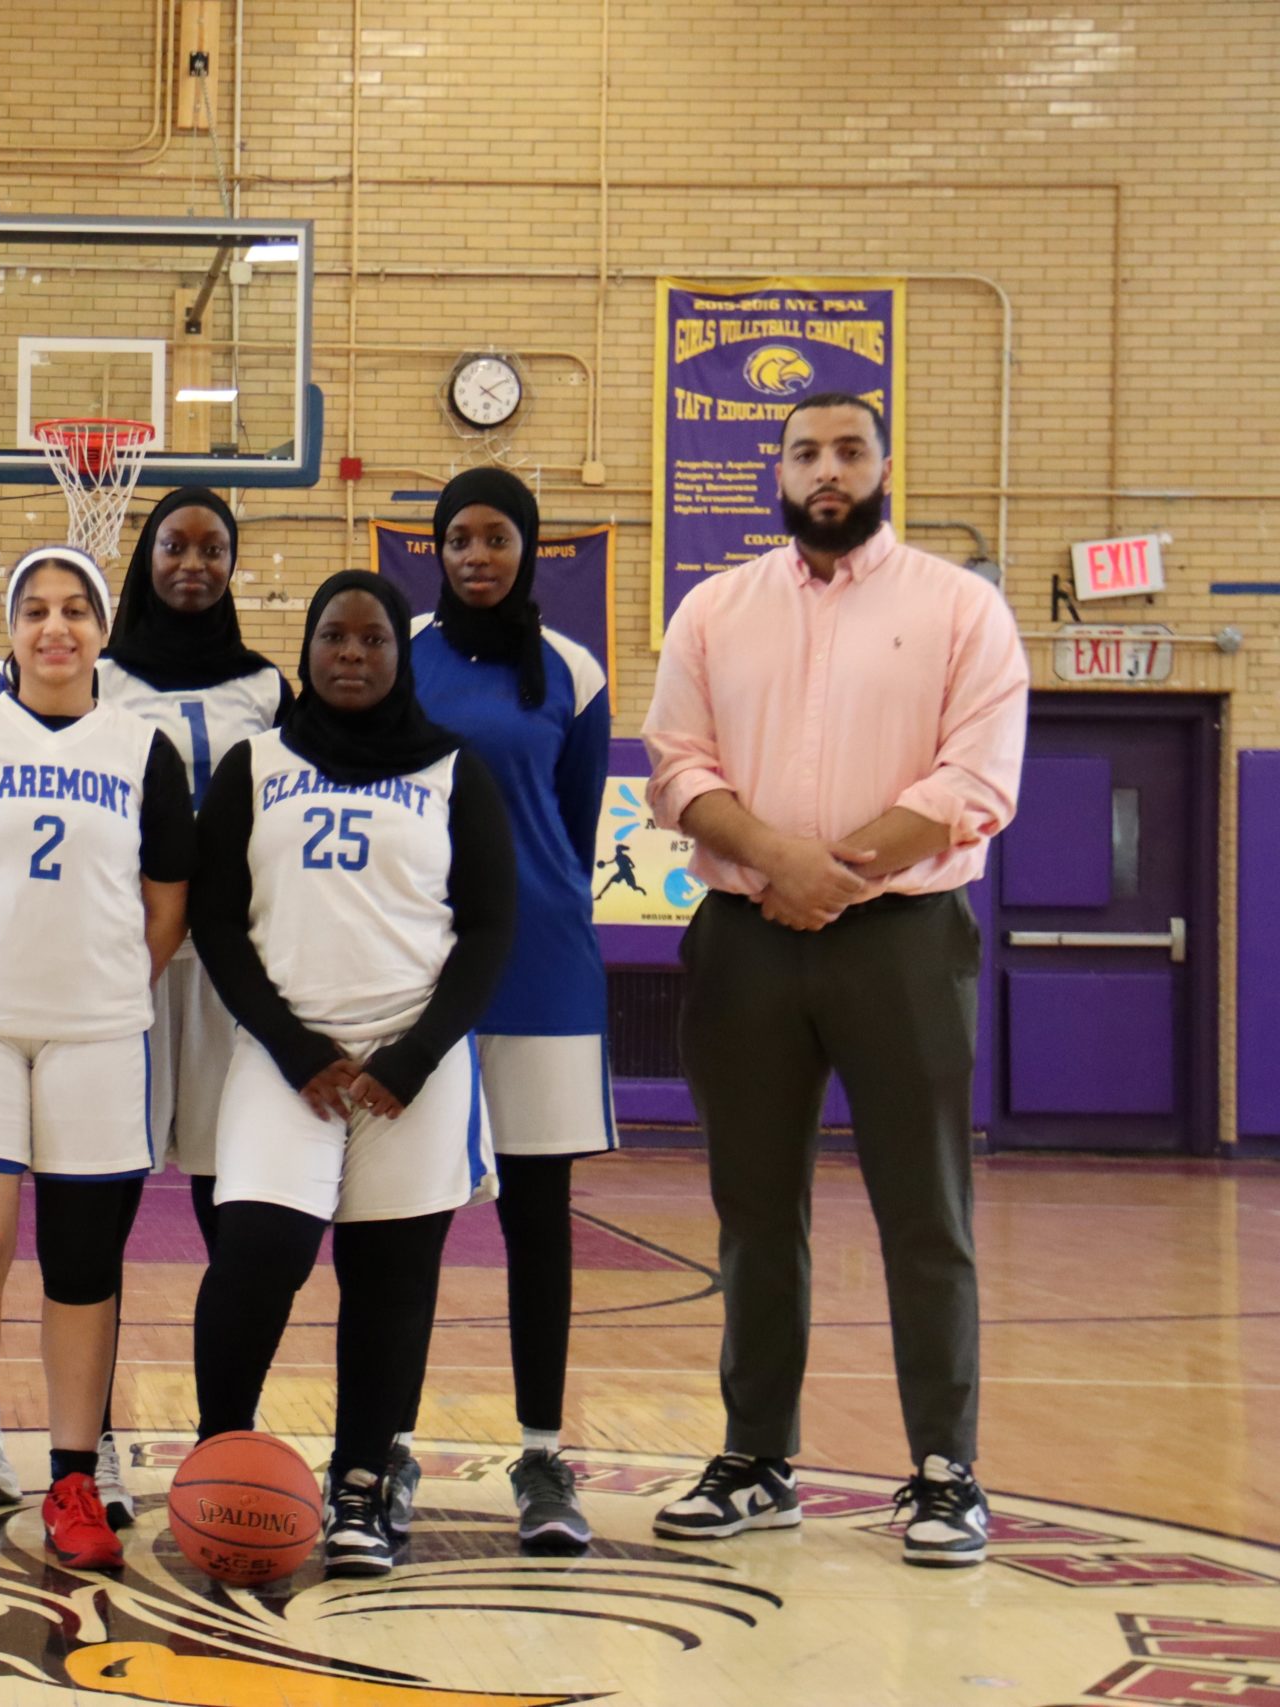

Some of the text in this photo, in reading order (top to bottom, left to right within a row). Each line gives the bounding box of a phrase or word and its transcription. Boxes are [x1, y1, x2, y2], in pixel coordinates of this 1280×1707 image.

[675, 319, 884, 366] GIRLS VOLLEYBALL CHAMPIONS
[674, 387, 797, 421] TAFT EDUCATIO
[406, 541, 577, 559] TAFT AMPUS
[1087, 540, 1148, 592] EXIT
[1074, 631, 1124, 675] EXIT
[180, 701, 212, 812] 1
[29, 814, 65, 881] 2
[303, 806, 373, 872] 25
[196, 1497, 298, 1537] SPALDING
[200, 1547, 278, 1569] EXCEL
